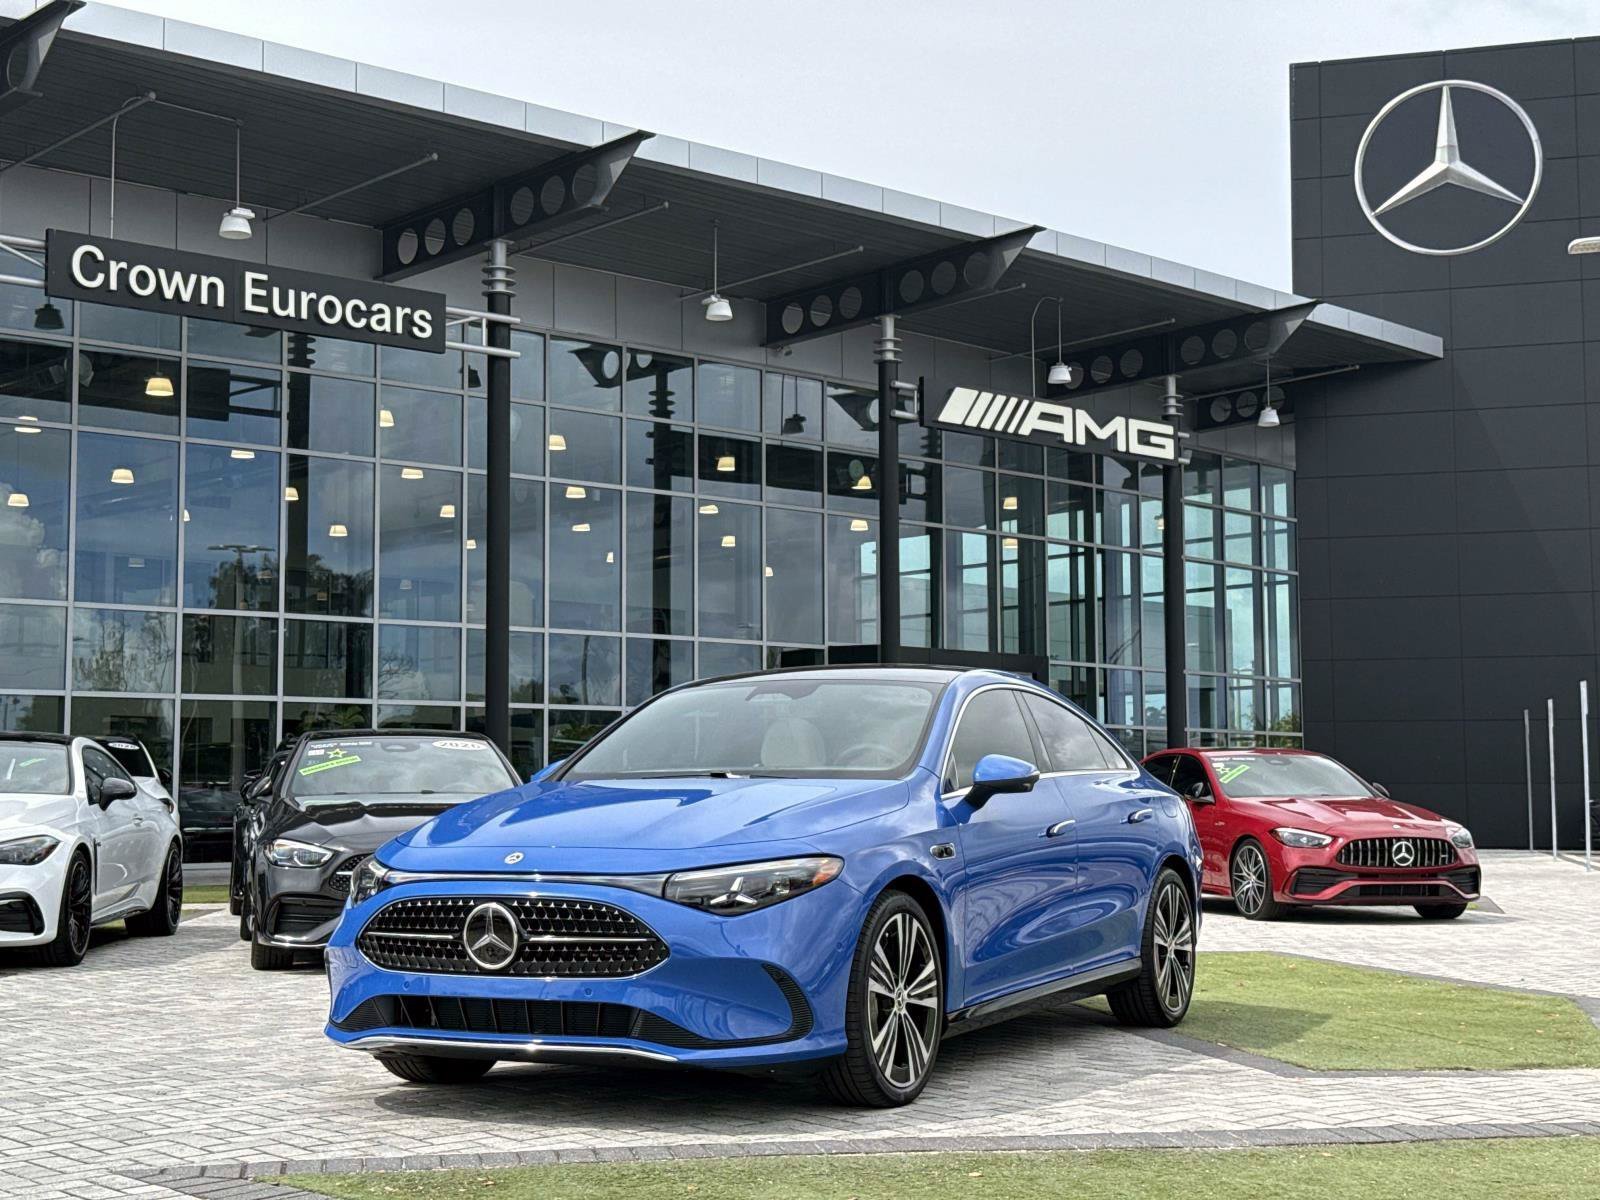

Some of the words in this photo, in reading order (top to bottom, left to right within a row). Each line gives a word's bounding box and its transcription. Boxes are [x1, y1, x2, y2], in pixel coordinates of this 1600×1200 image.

[71, 244, 225, 307] Crown
[243, 270, 433, 339] Eurocars
[1018, 400, 1175, 460] AMG
